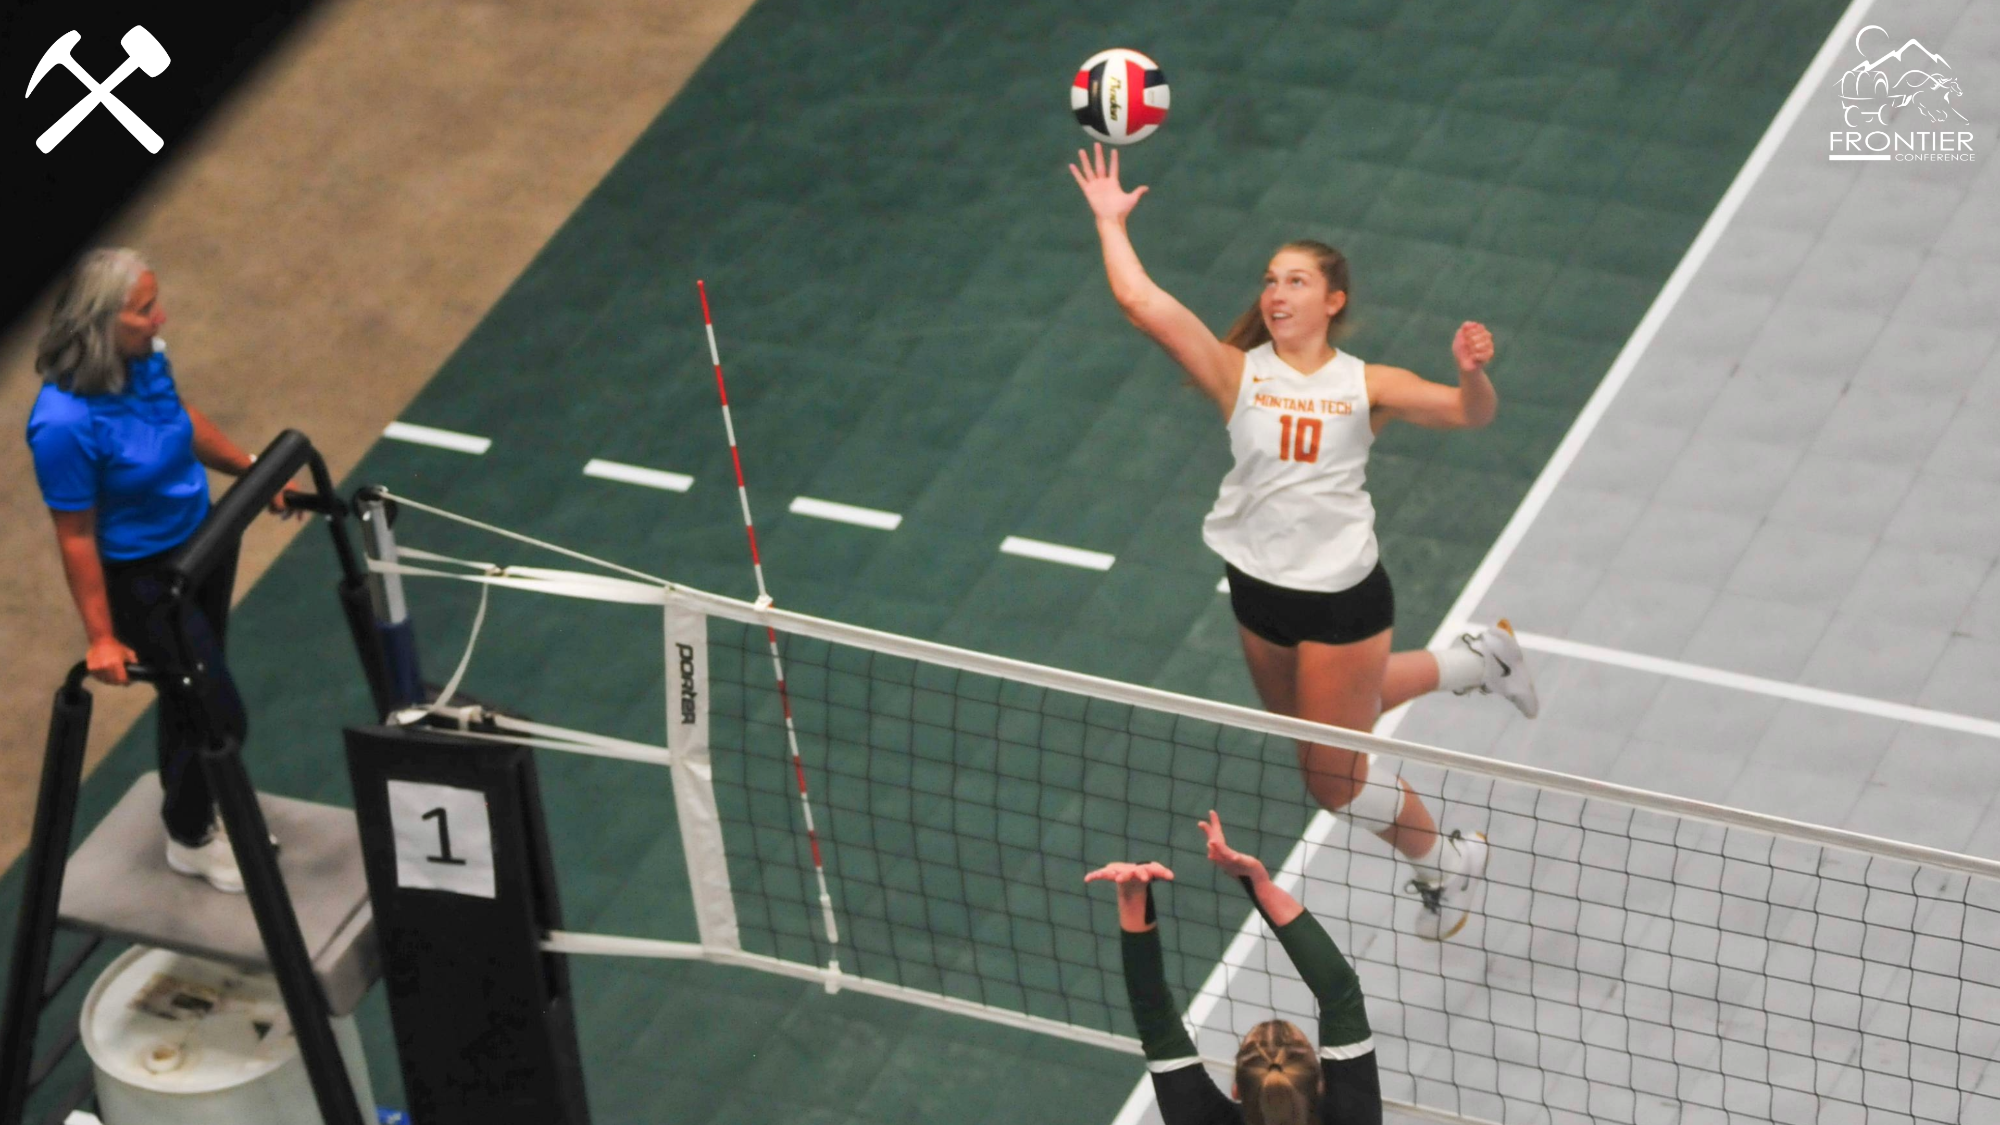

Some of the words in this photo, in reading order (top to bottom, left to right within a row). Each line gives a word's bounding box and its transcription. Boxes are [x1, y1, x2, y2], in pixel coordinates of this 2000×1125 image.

[1253, 392, 1315, 413] MONTANA
[1320, 399, 1353, 416] TECH
[1279, 414, 1323, 464] 10
[421, 806, 467, 867] 1
